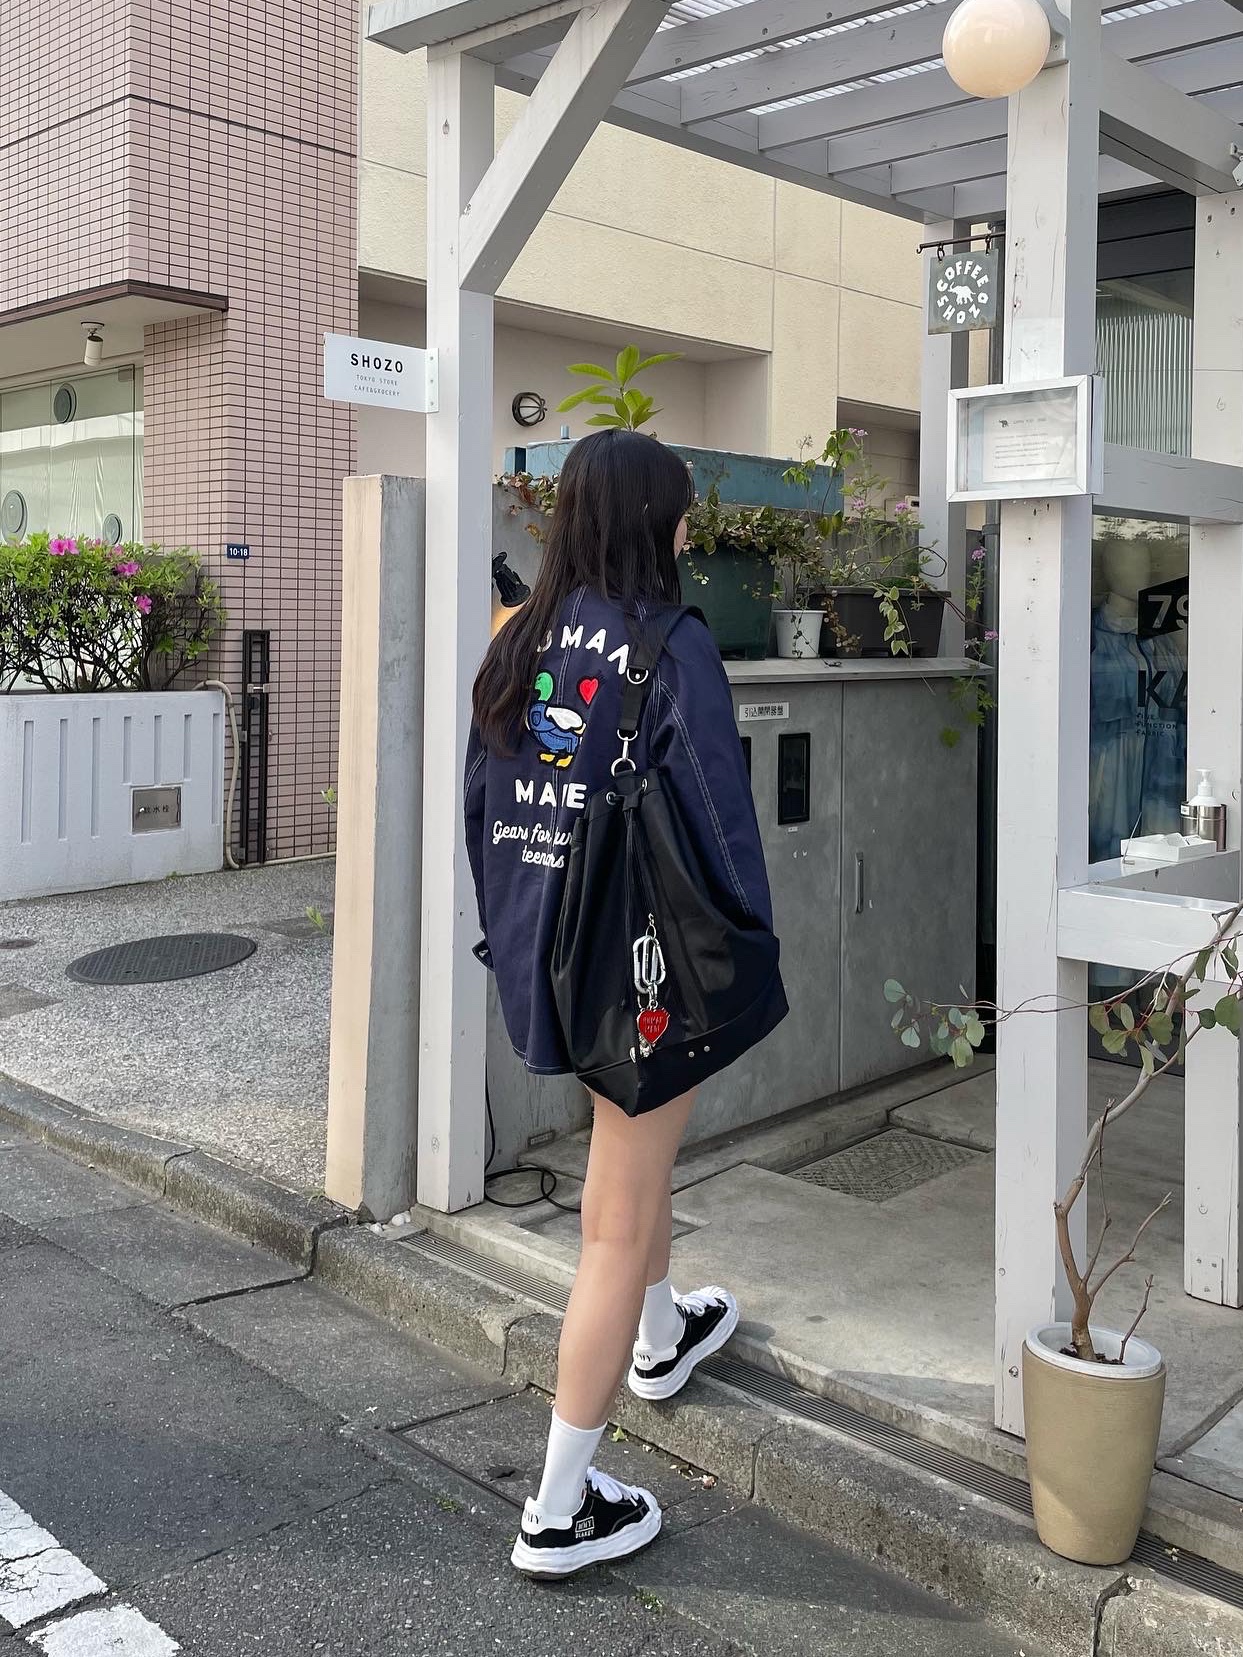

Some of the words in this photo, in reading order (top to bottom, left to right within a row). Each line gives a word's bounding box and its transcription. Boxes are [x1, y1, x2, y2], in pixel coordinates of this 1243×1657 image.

[936, 260, 989, 292] COFFEE
[936, 292, 989, 324] SHOZO
[350, 353, 403, 373] SHOZO
[356, 374, 376, 383] TOKYO
[379, 378, 398, 386] STORE
[354, 385, 400, 397] CAFE&GROCERY
[229, 547, 248, 557] 10-18
[493, 820, 529, 845] Gears
[530, 822, 552, 844] for
